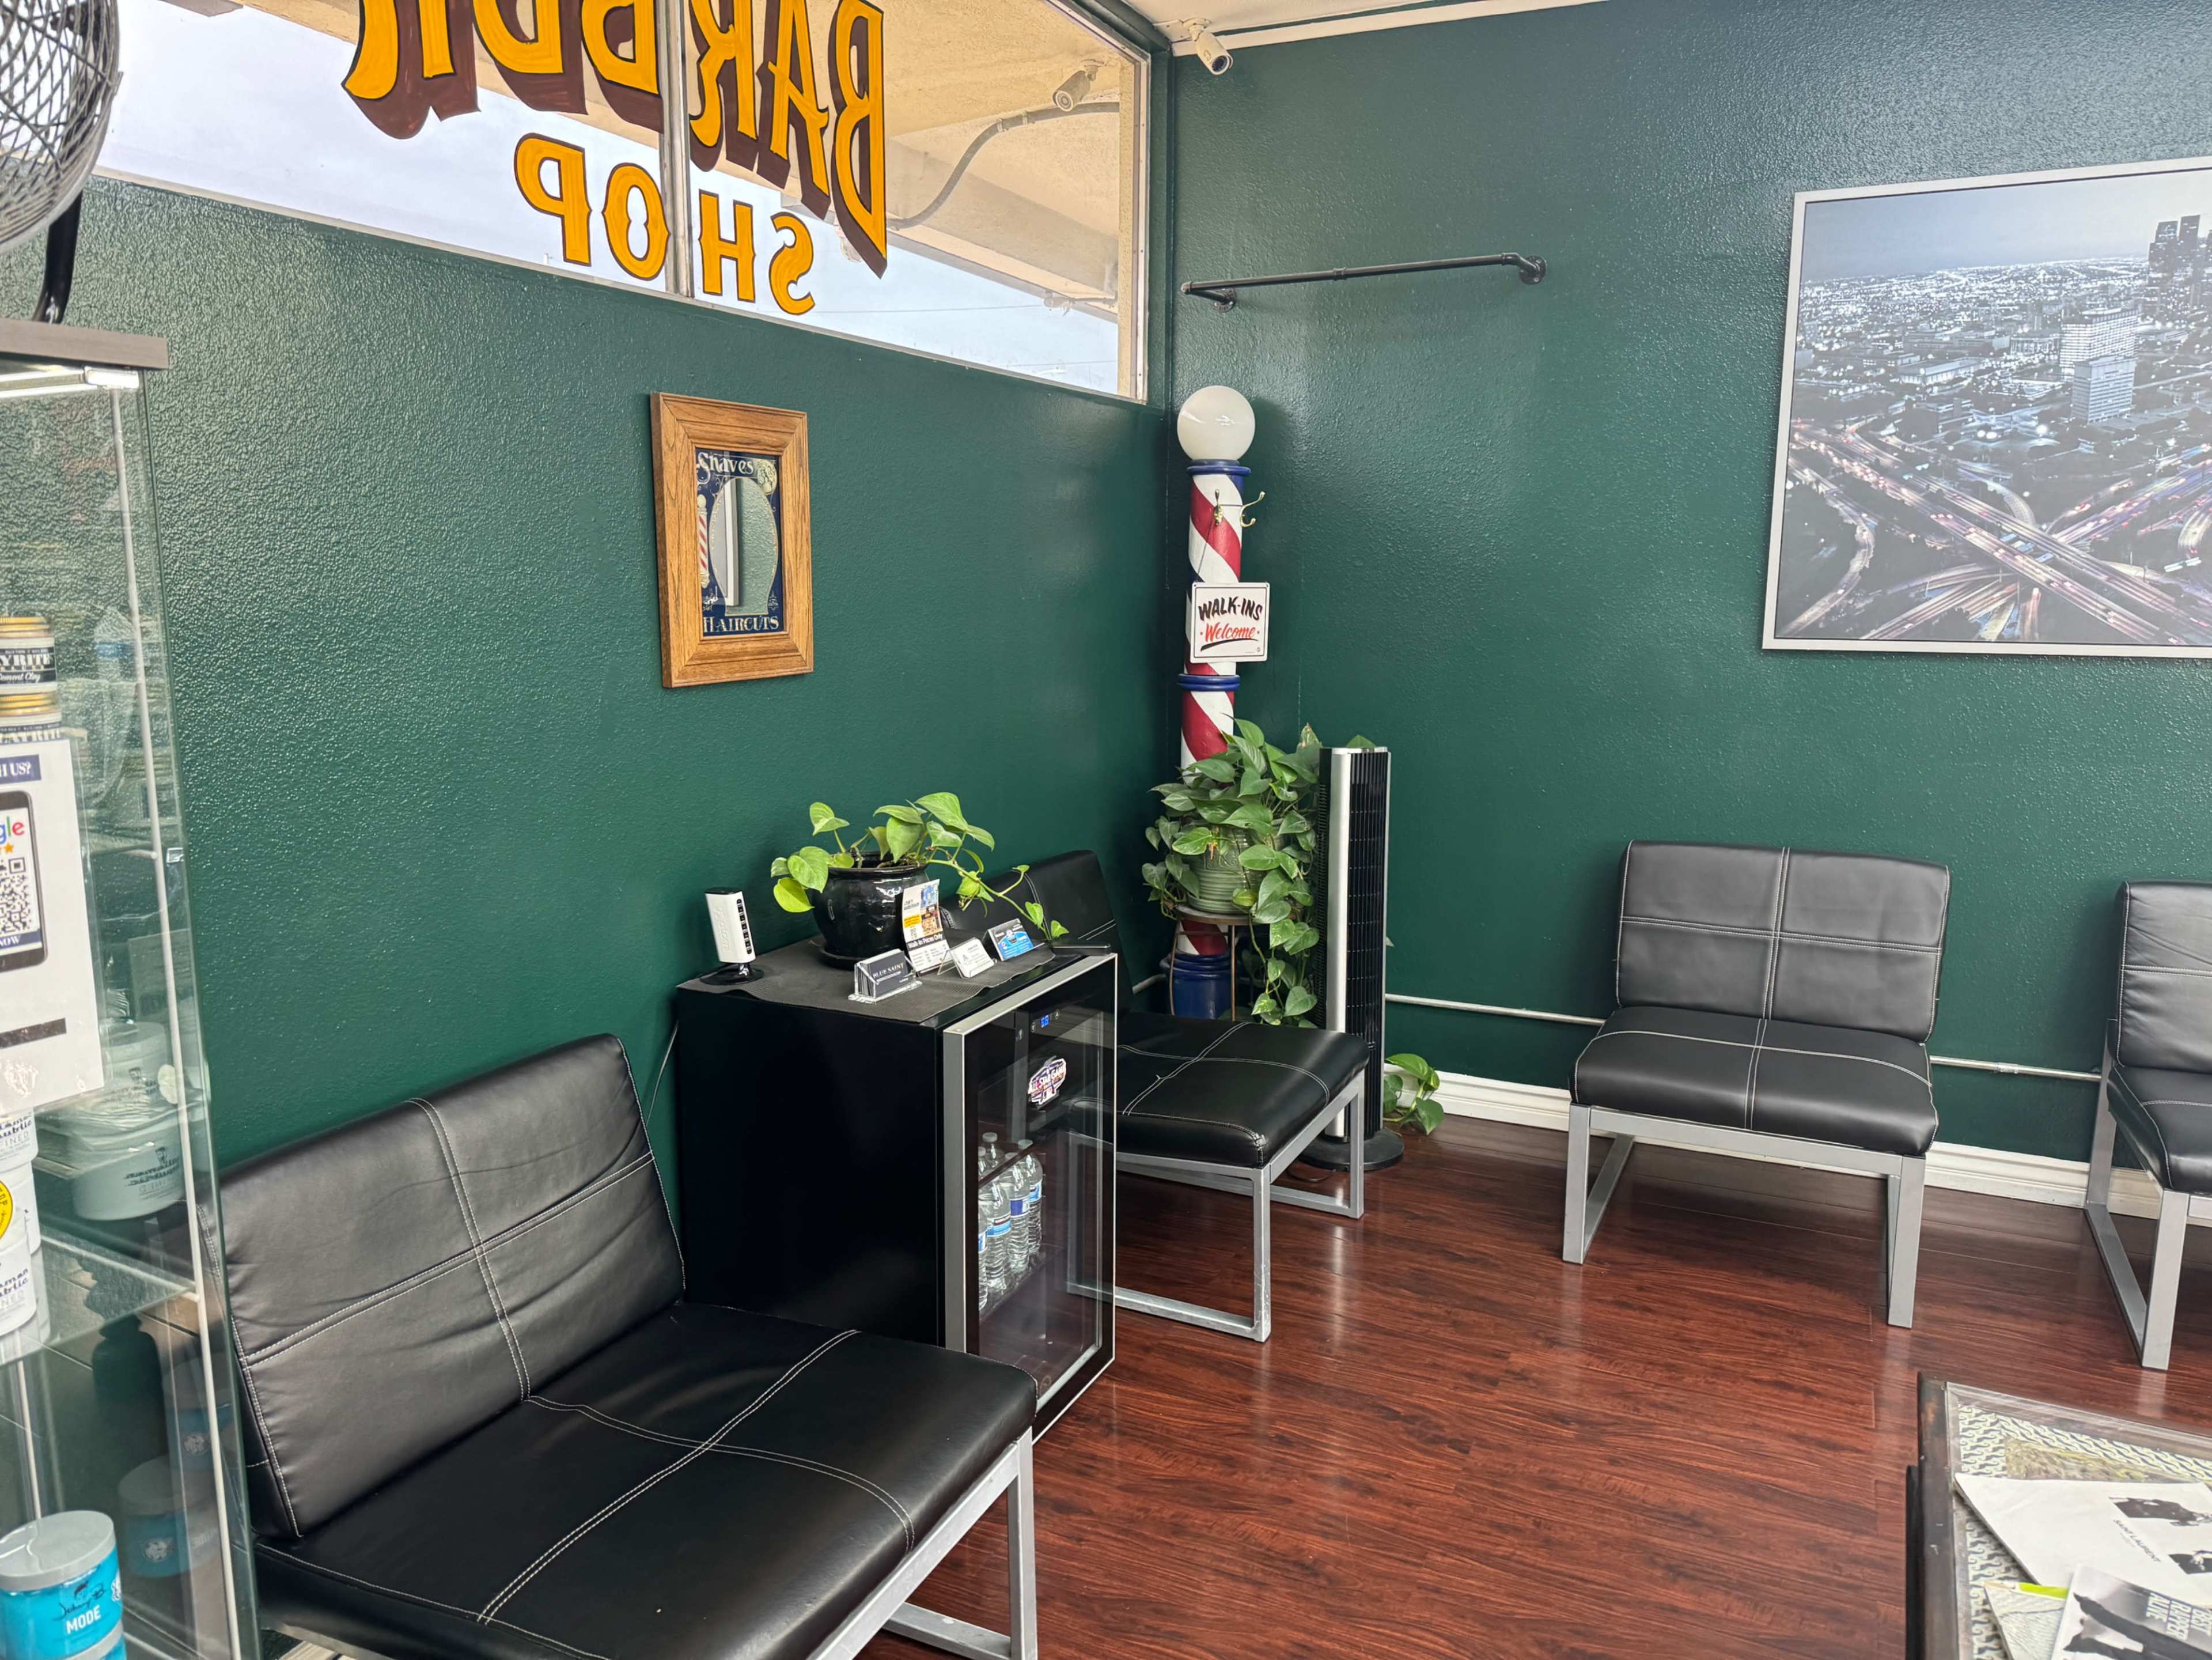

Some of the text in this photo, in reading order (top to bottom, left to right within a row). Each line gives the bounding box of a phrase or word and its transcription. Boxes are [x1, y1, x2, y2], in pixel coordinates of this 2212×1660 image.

[1198, 596, 1263, 621] WALK-INS
[703, 616, 779, 633] HAIRCUTS
[1205, 622, 1256, 642] Welcome
[9, 761, 32, 776] US?
[2146, 1592, 2171, 1623] ALIVE
[66, 1604, 101, 1634] MODE
